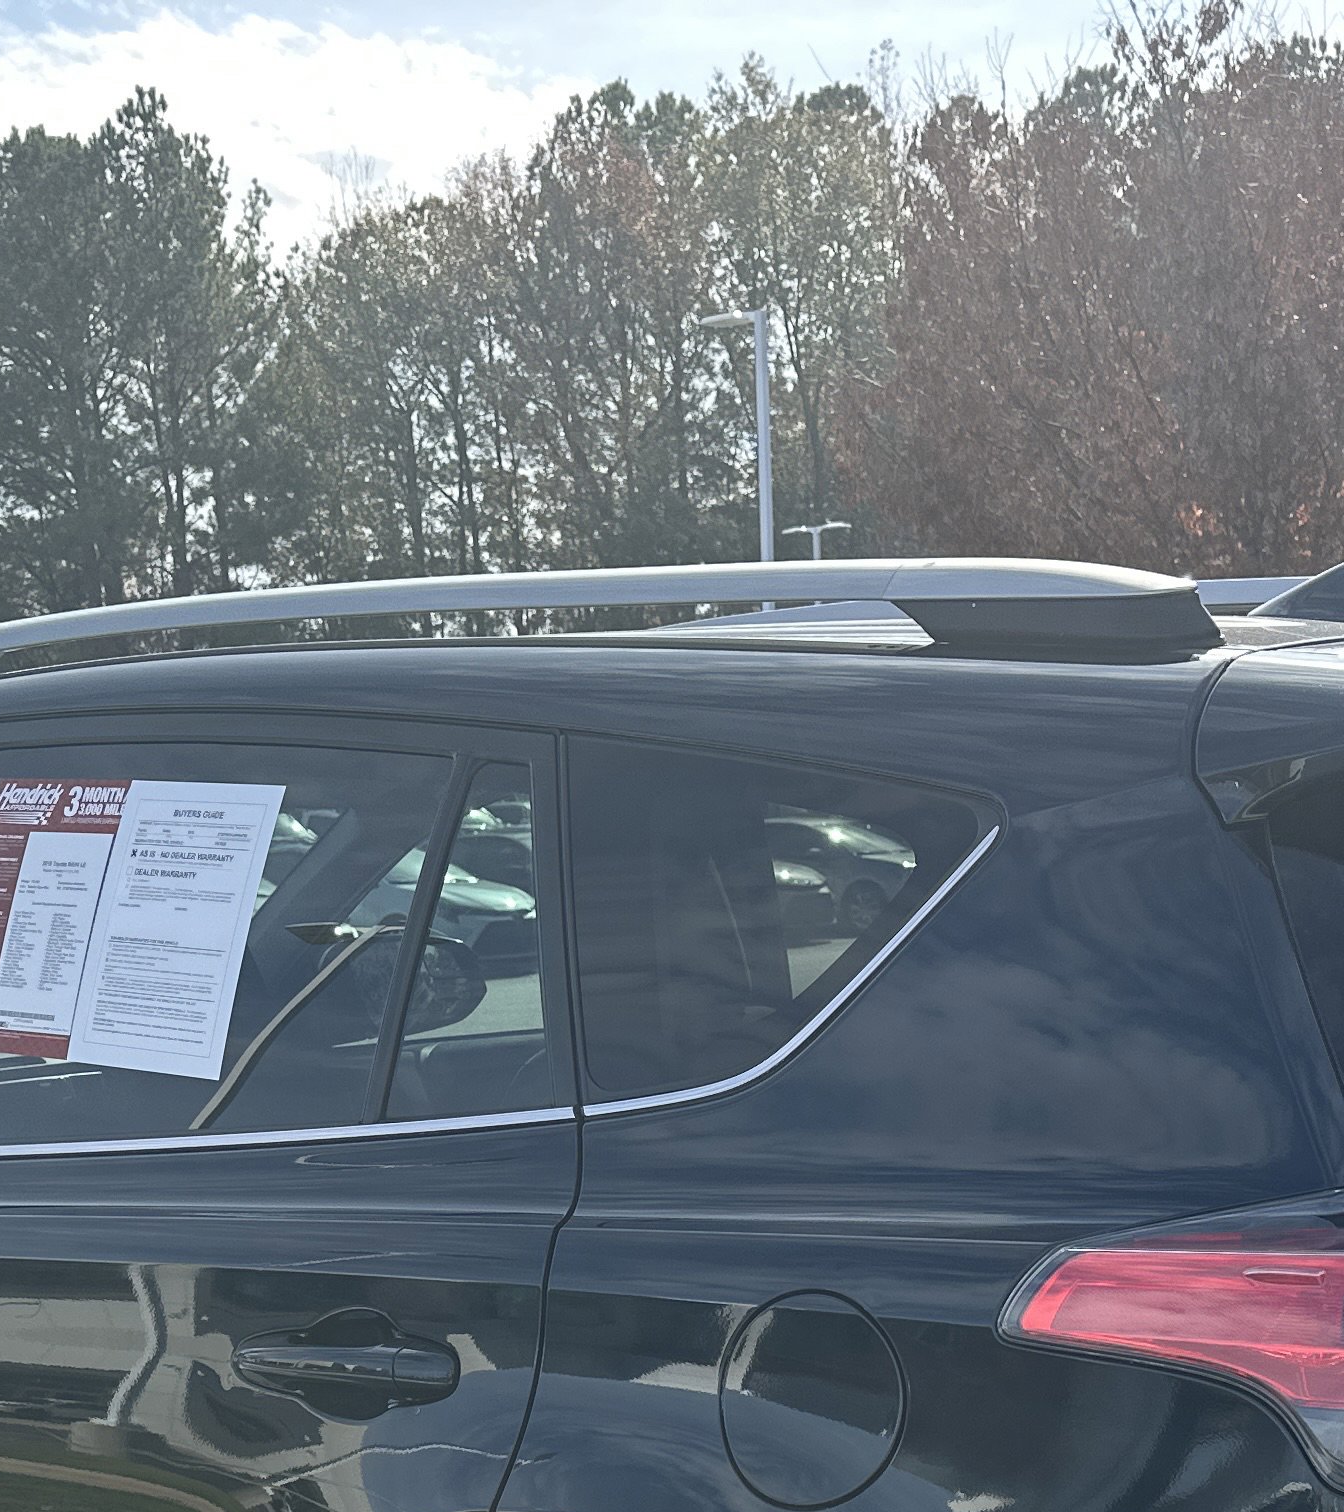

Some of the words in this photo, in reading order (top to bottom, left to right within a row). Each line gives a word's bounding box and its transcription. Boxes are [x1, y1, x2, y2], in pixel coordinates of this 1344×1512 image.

[64, 786, 83, 816] 3
[79, 803, 103, 816] 3,000
[173, 809, 202, 819] BUYERS
[203, 810, 225, 820] GUIDE
[171, 851, 196, 860] DEALER
[197, 853, 234, 863] WARRANTY
[134, 868, 159, 877] DEALER
[160, 869, 197, 879] WARRANTY
